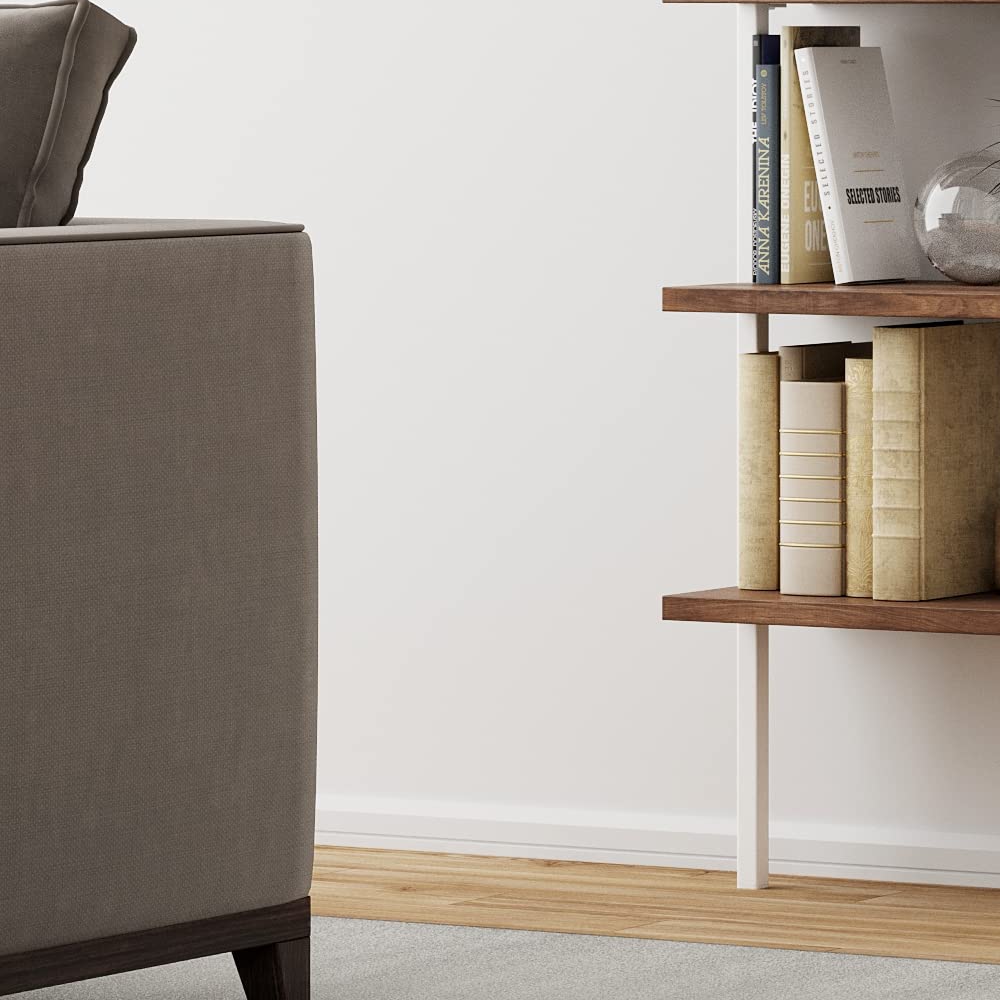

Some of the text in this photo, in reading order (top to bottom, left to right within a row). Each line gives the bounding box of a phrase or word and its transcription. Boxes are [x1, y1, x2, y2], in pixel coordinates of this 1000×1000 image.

[803, 70, 831, 196] SELECTED STORIES
[758, 137, 770, 276] ANNA KARENINA
[781, 153, 790, 273] EUGENE ONEGIN
[846, 186, 901, 205] SELECTED STORIES
